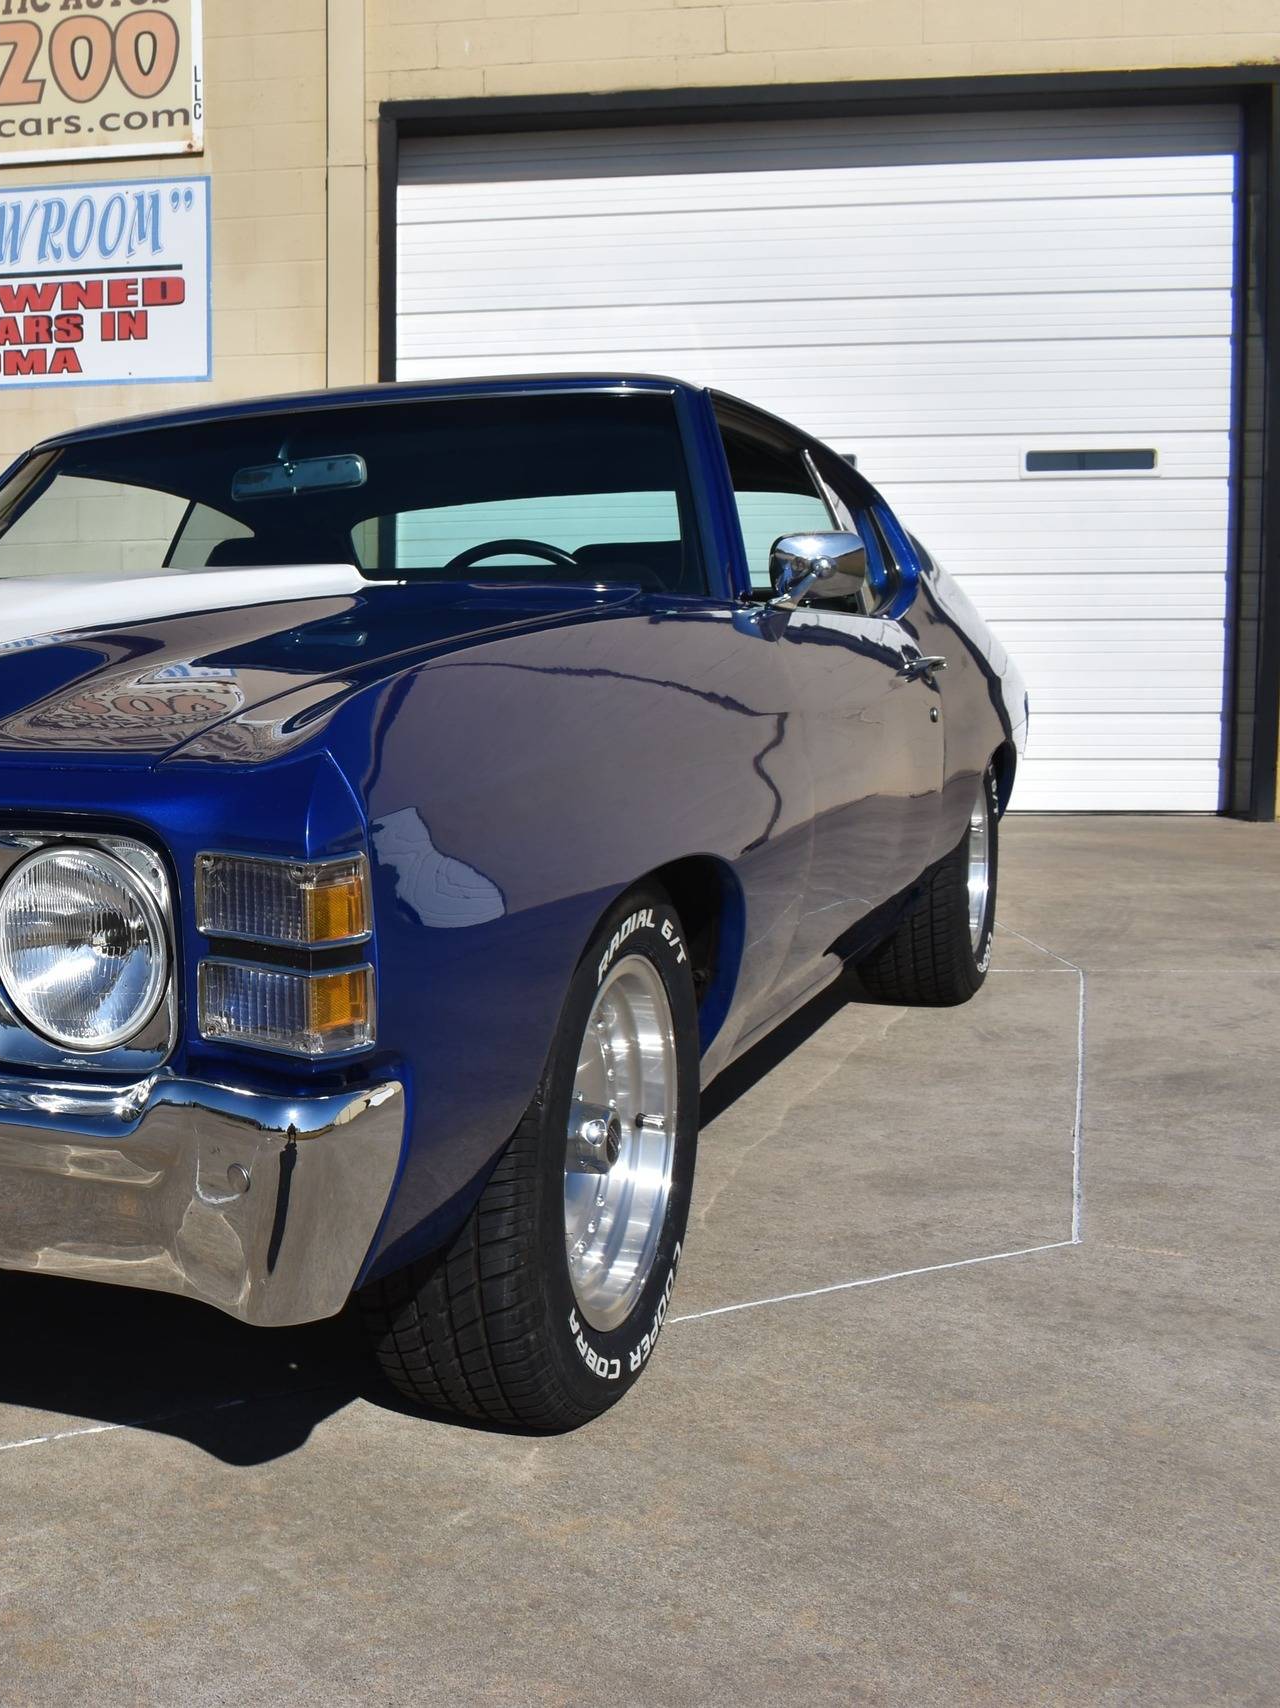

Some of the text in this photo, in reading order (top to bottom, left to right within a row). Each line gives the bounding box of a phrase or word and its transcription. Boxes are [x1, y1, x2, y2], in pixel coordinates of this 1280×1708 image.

[193, 64, 202, 120] LLC
[101, 310, 149, 342] IN
[597, 907, 656, 987] RADIAL
[568, 1240, 682, 1380] COOPER COBRA
